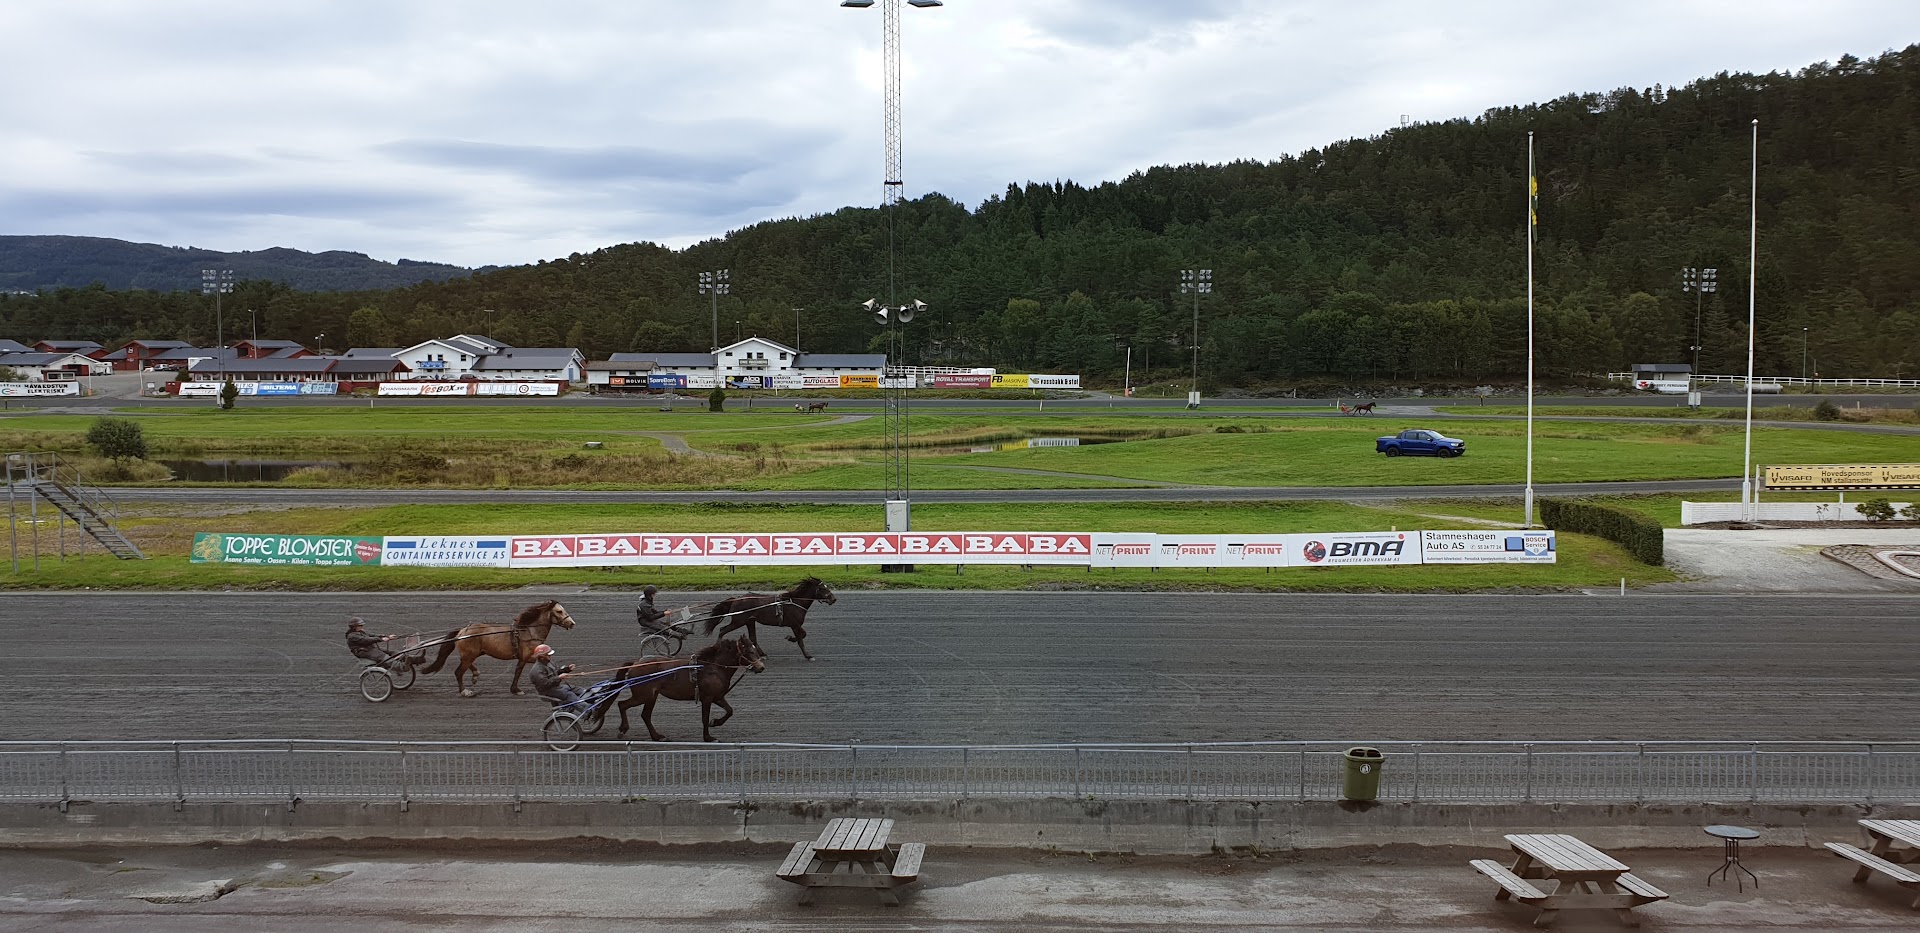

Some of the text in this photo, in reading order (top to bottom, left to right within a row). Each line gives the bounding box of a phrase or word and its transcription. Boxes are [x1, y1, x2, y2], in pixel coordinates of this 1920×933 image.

[1821, 470, 1873, 478] Hovedsponsor
[419, 537, 475, 549] Leknes
[643, 537, 703, 555] BA
[709, 537, 768, 555] BA
[773, 536, 832, 554] BA
[838, 536, 896, 554] BA
[902, 536, 960, 554] BA
[966, 535, 1024, 553] BA
[1029, 535, 1089, 553] BA
[1426, 532, 1496, 542] Stamneshagen
[1426, 542, 1465, 550] Auto AS
[225, 536, 275, 555] TOPPE
[277, 537, 352, 557] BLOMSTER
[386, 550, 488, 560] CONTAINERSERVICE
[492, 550, 506, 559] AS
[514, 539, 573, 557] BA
[579, 538, 638, 556] BA
[1329, 540, 1405, 557] BMA
[224, 555, 243, 563] Åsane
[243, 556, 262, 564] Senter
[291, 557, 310, 565] Kilden
[315, 558, 333, 567] Toppe
[333, 558, 352, 566] Senter
